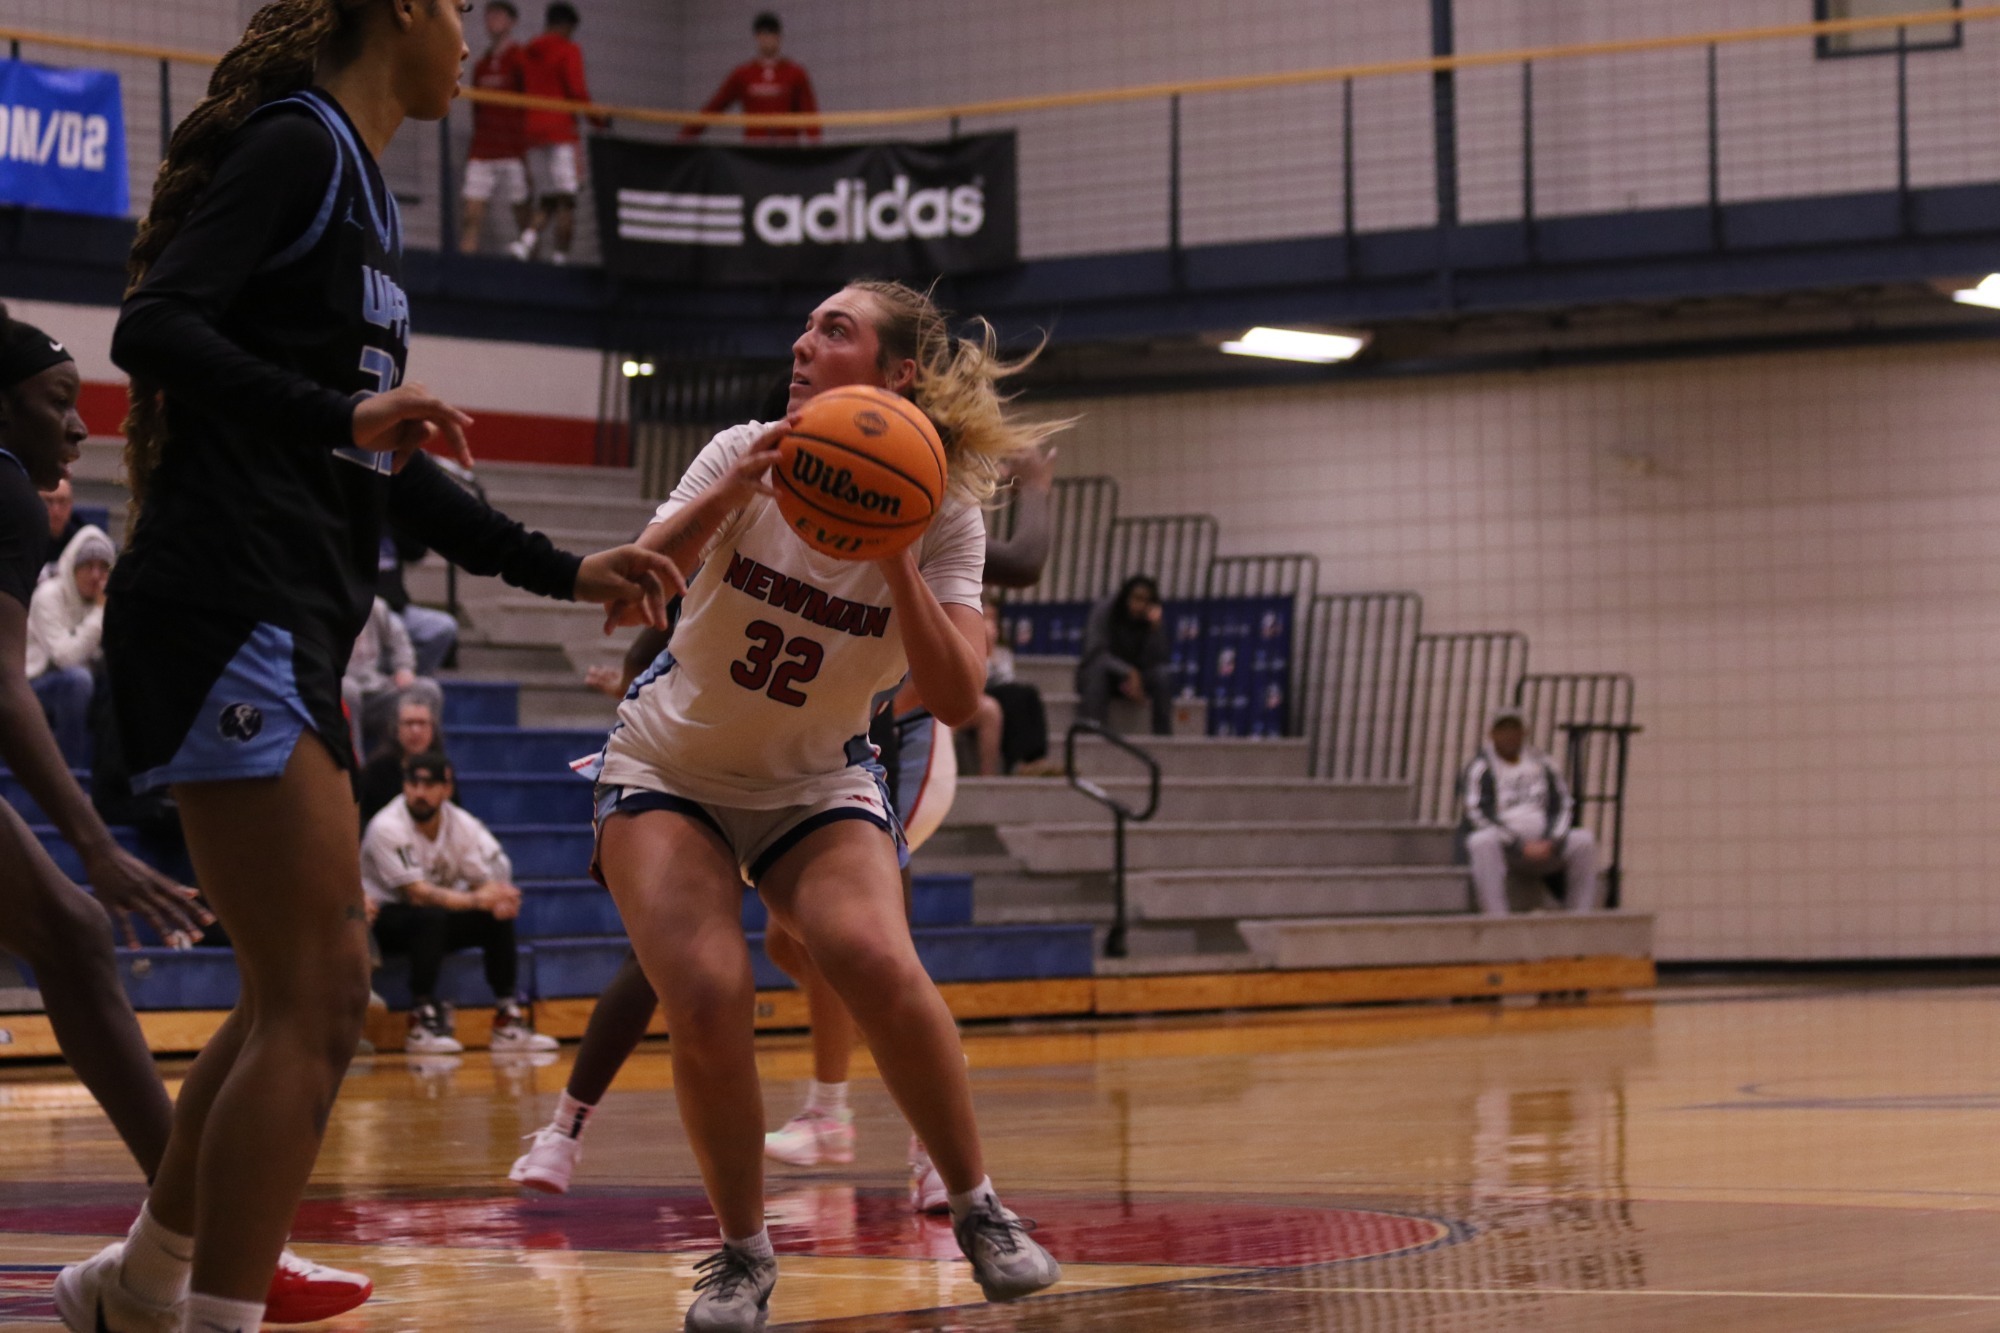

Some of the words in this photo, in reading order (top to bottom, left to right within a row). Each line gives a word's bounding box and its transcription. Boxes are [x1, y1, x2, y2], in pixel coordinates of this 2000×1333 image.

[752, 174, 985, 246] adidas
[792, 447, 902, 518] Wilson
[722, 548, 892, 639] NEWMAN
[730, 619, 824, 708] 32
